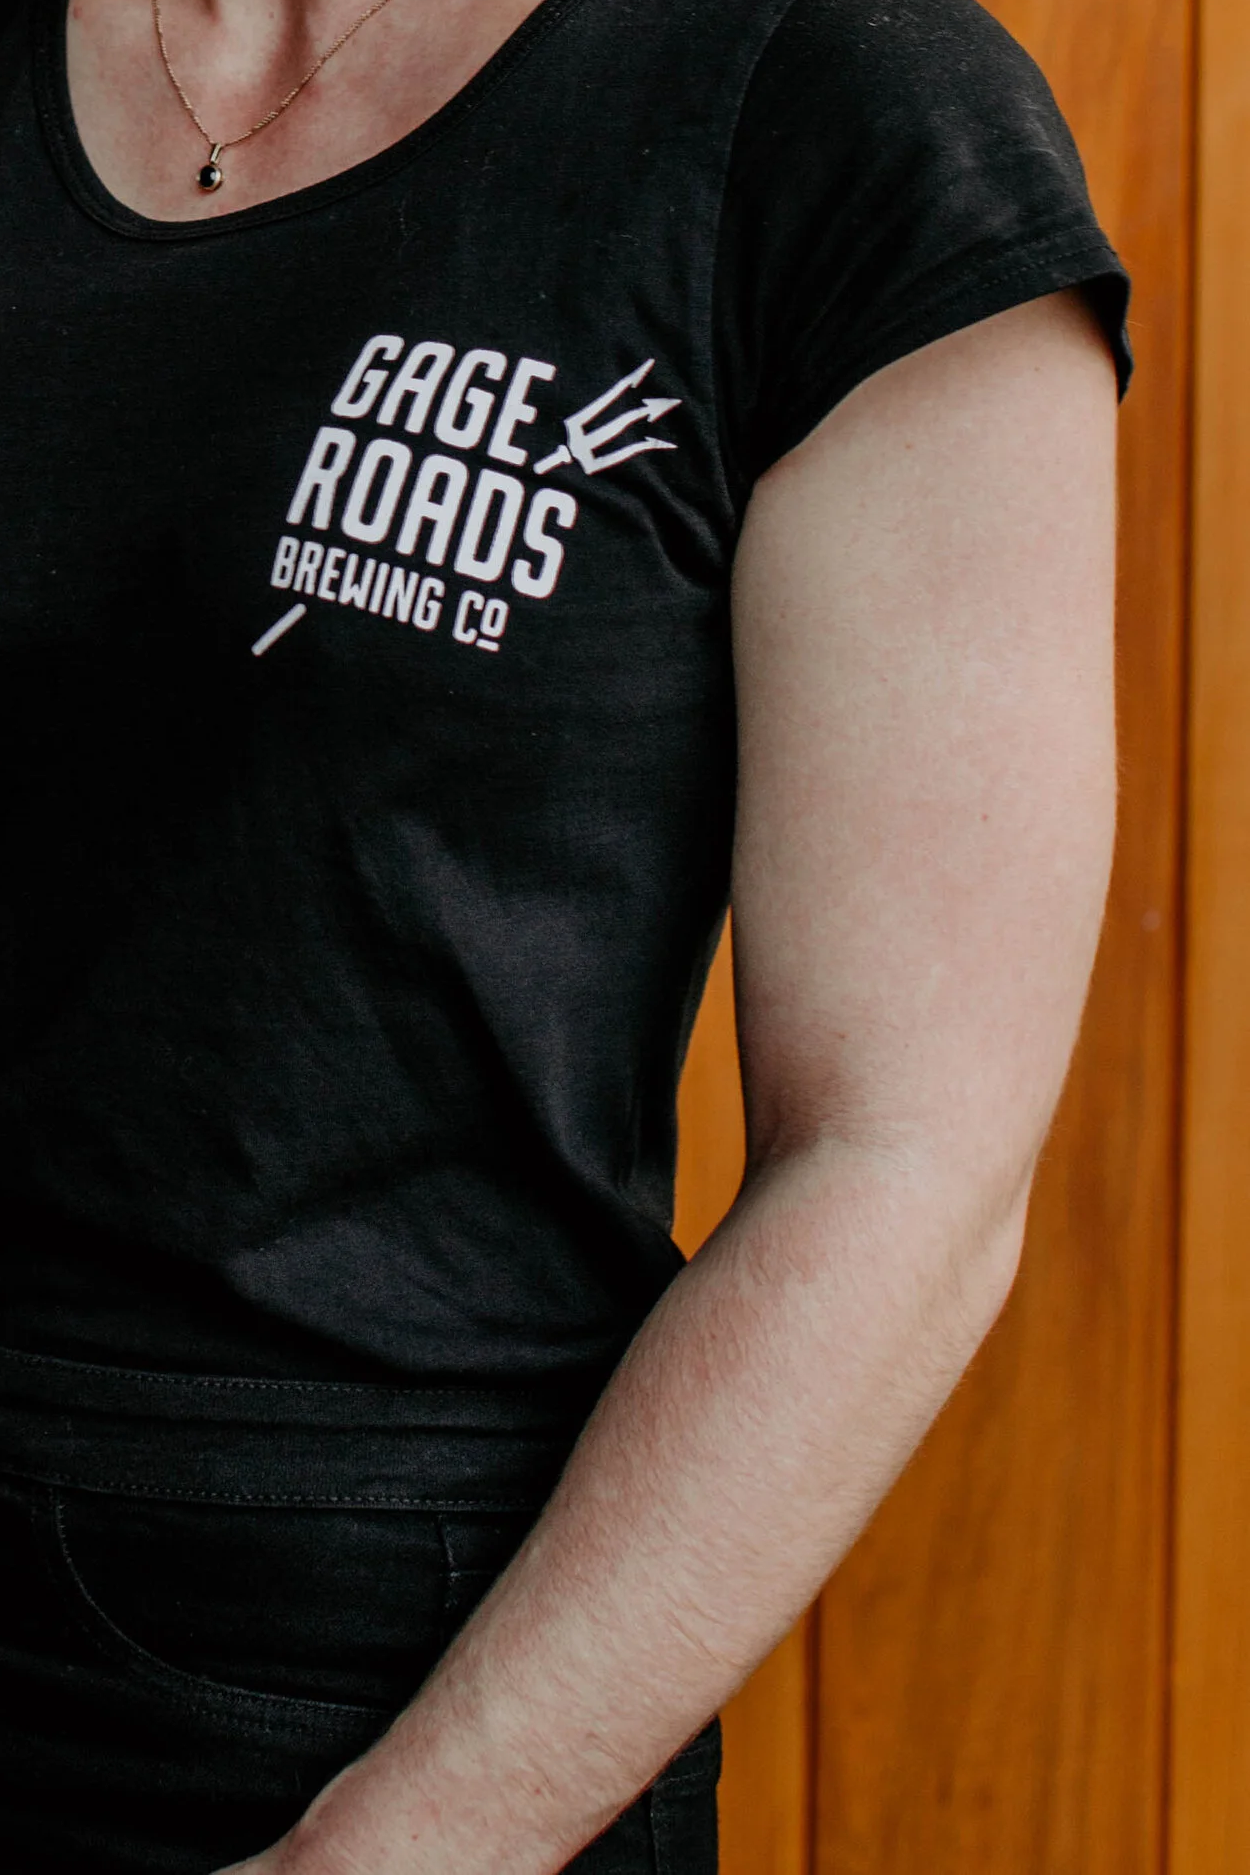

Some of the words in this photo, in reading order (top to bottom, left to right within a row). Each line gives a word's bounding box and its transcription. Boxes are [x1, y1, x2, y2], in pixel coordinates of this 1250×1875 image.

[330, 334, 557, 466] GAGE
[286, 426, 578, 599] ROADS
[270, 536, 446, 631] BREWING
